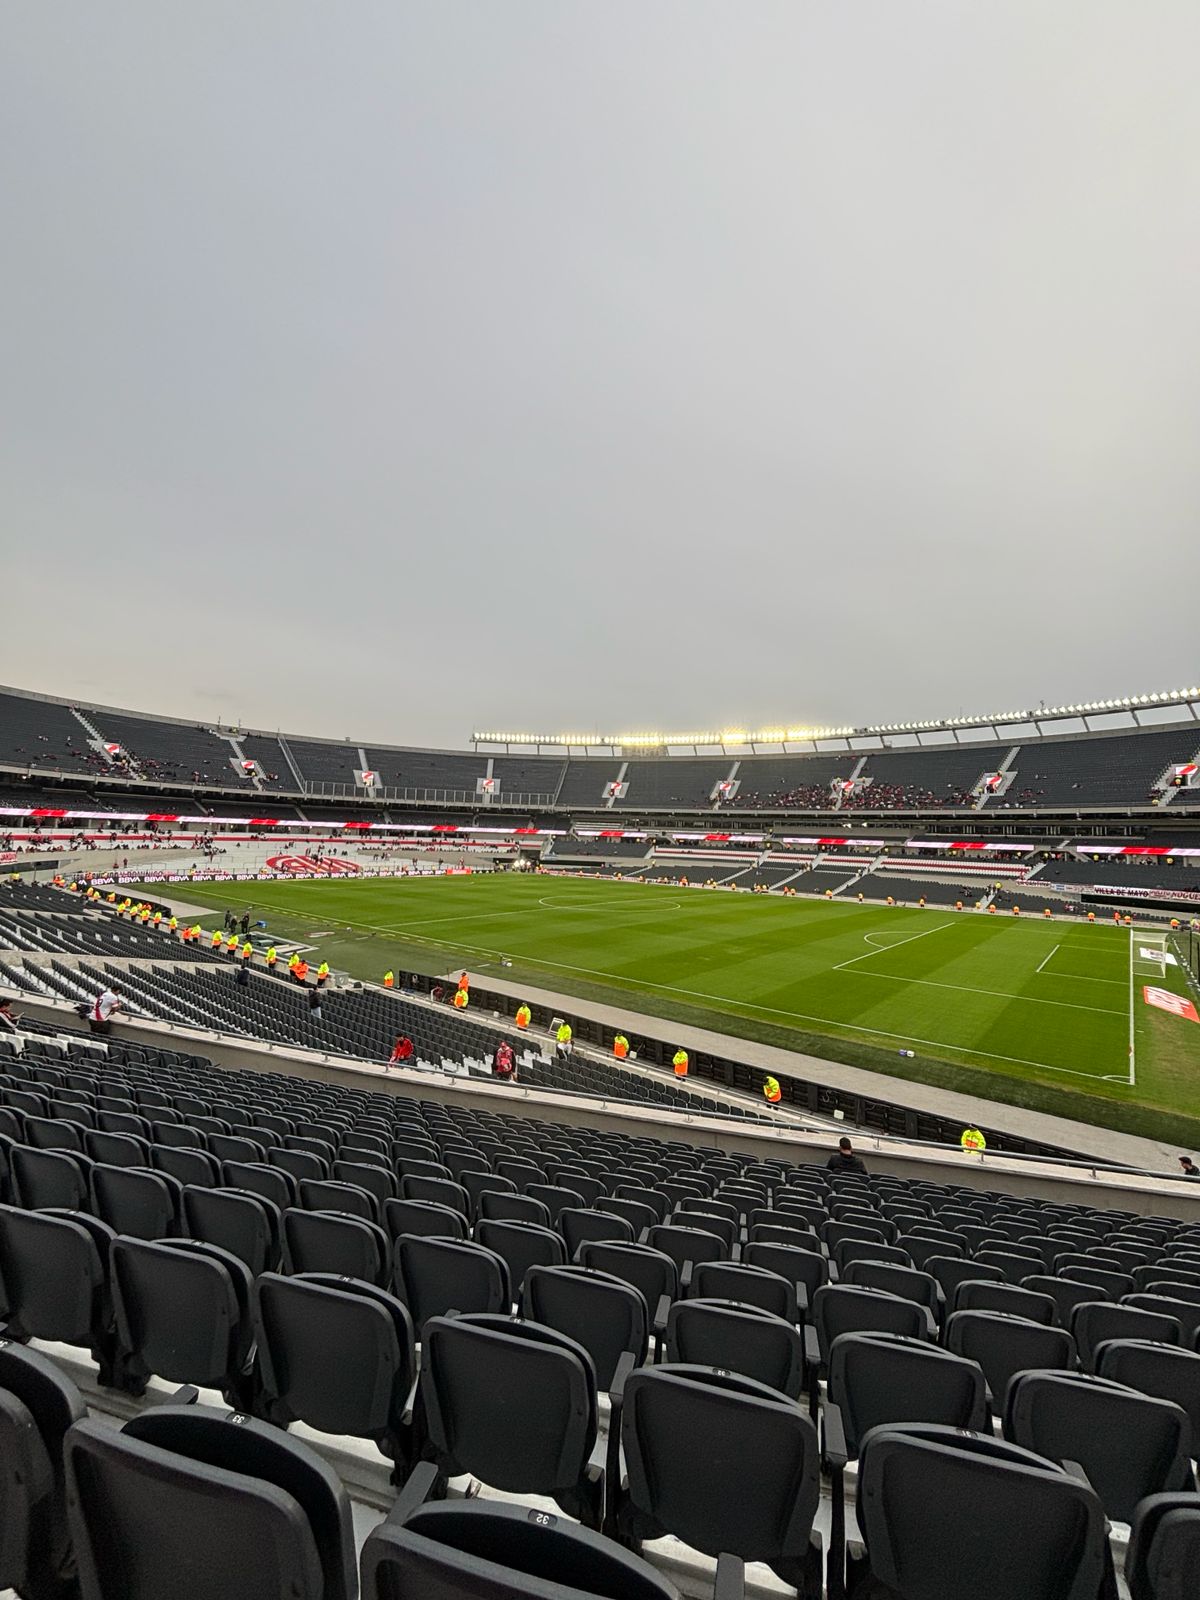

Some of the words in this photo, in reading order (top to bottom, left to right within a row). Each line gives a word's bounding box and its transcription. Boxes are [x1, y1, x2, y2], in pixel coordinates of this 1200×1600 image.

[1094, 887, 1115, 895] VILLA
[1127, 889, 1149, 897] MAYO
[232, 1414, 245, 1424] 33
[536, 1513, 550, 1525] 32
